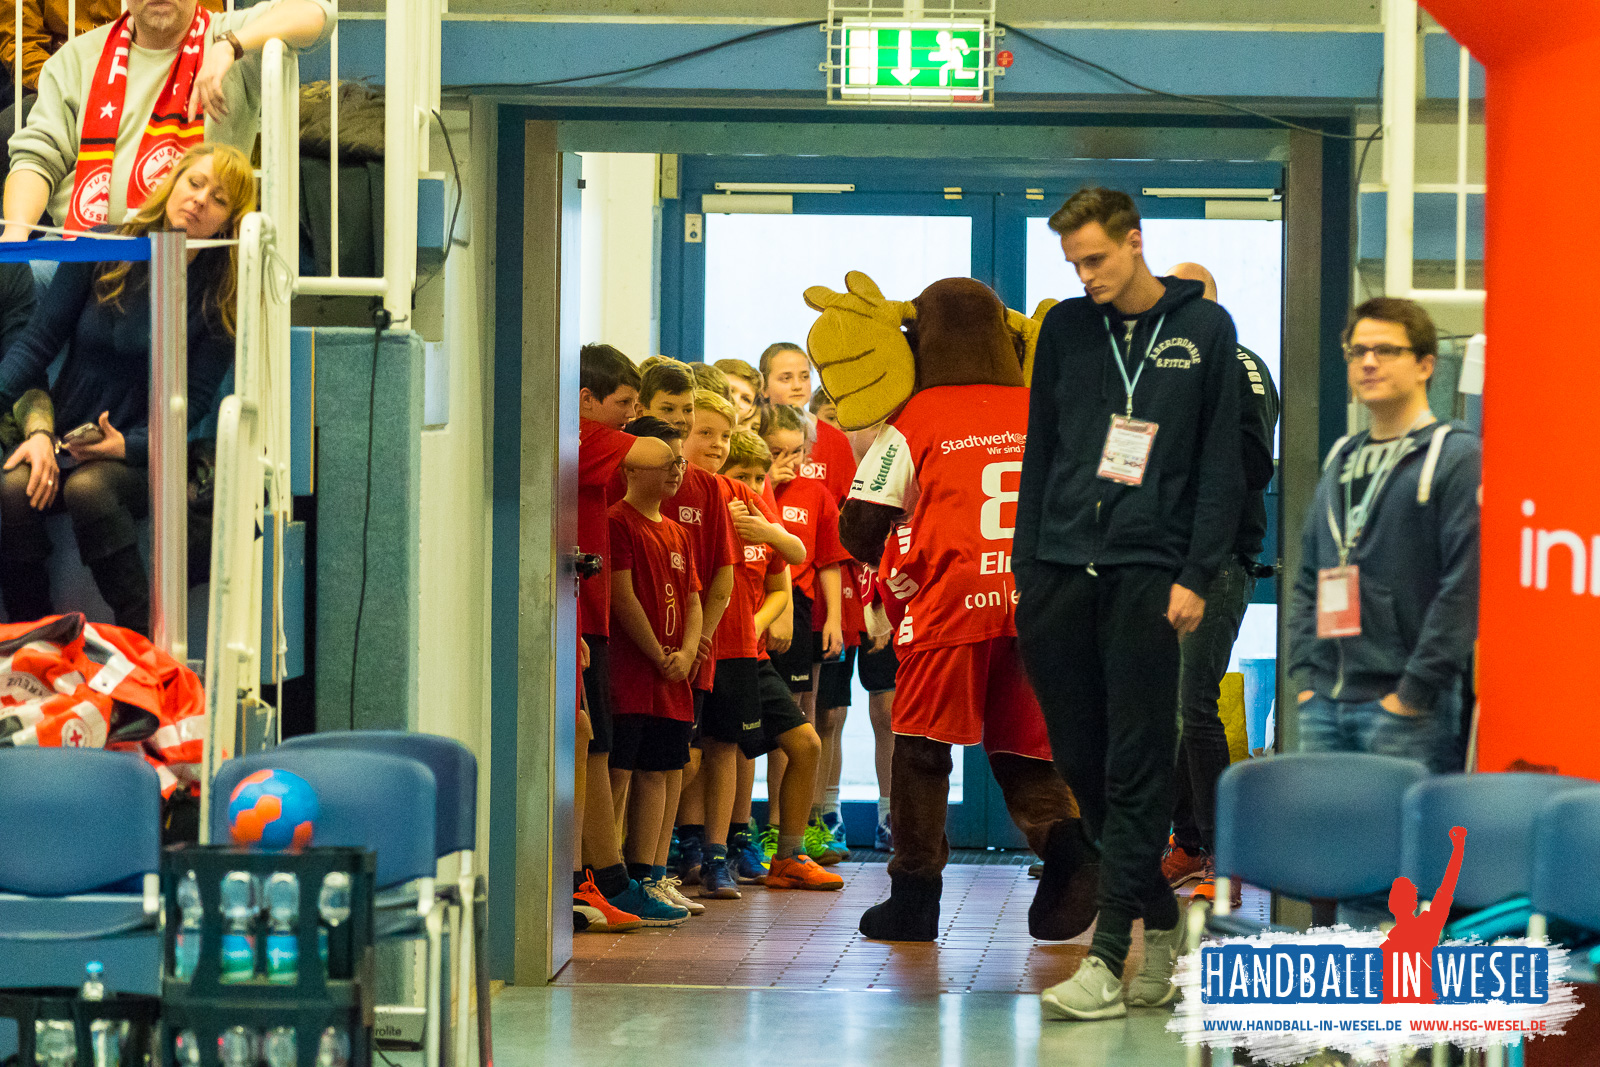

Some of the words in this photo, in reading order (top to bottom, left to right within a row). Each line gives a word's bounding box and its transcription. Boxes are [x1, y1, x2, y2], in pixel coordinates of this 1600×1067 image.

[1149, 337, 1201, 364] ABERCROMBIE
[869, 444, 898, 493] Stauder
[986, 446, 1002, 455] Wir
[1003, 445, 1021, 454] sind
[980, 460, 1023, 541] 8
